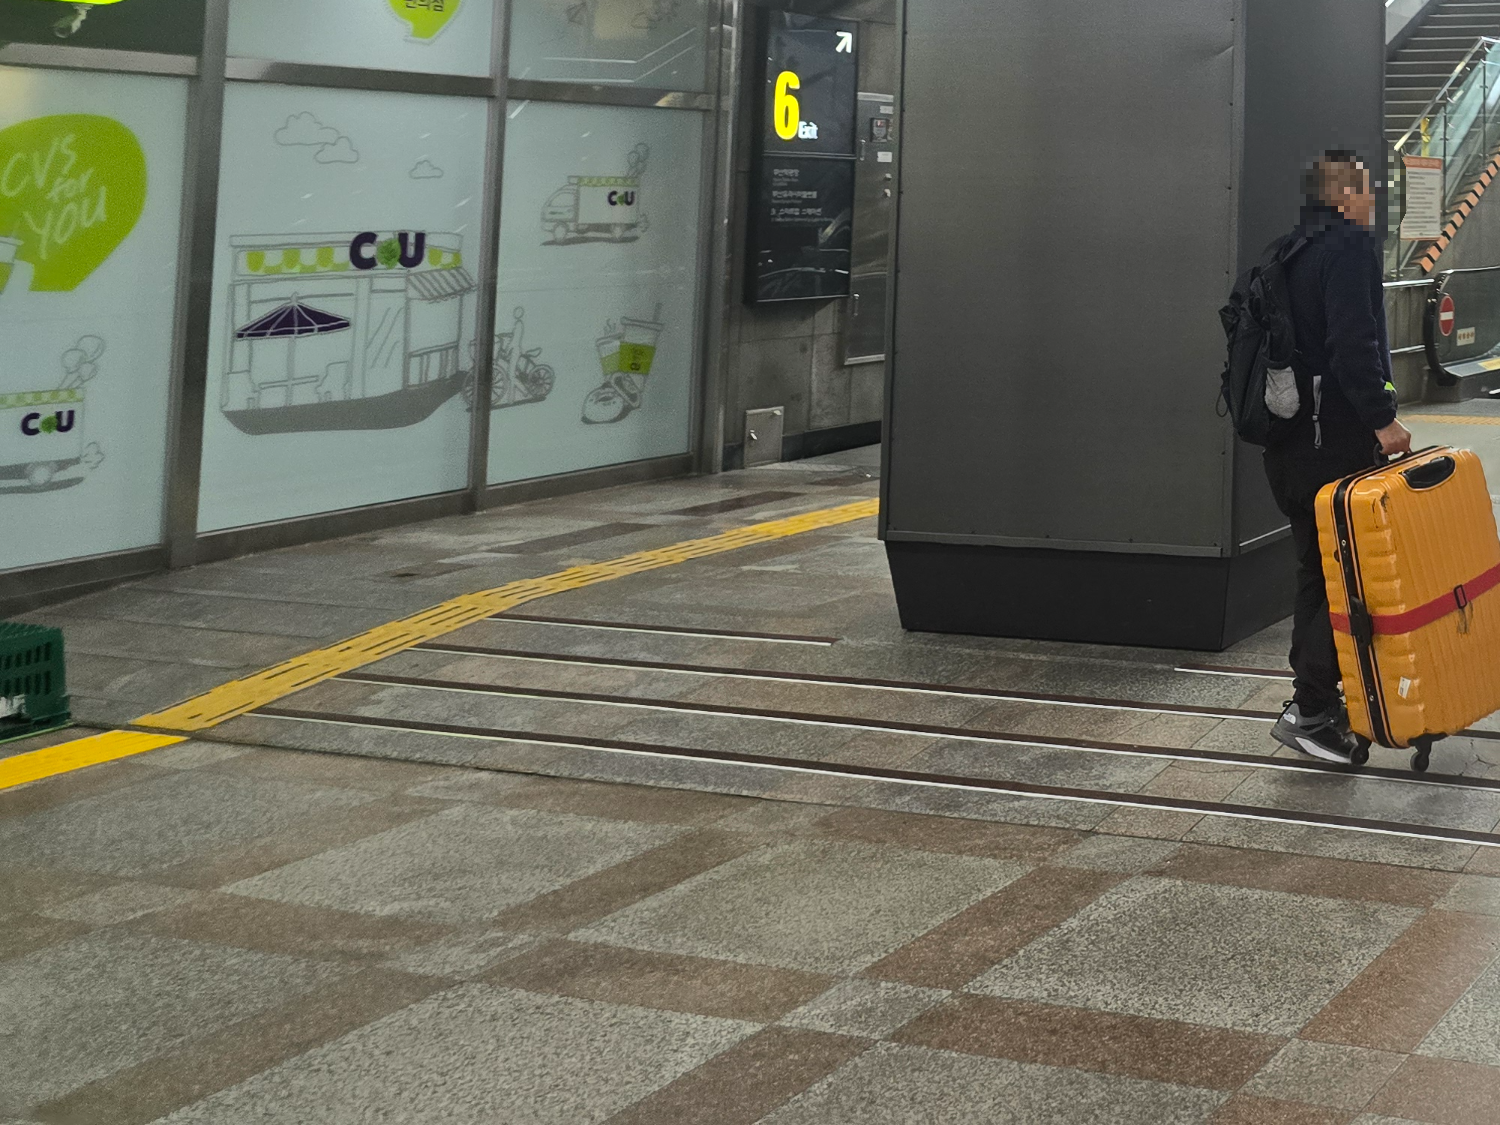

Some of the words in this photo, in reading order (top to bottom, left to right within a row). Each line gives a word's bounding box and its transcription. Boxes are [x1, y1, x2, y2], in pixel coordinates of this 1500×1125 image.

[773, 69, 801, 141] 6
[606, 190, 636, 207] CU
[349, 230, 427, 270] CU
[21, 409, 76, 436] CU
